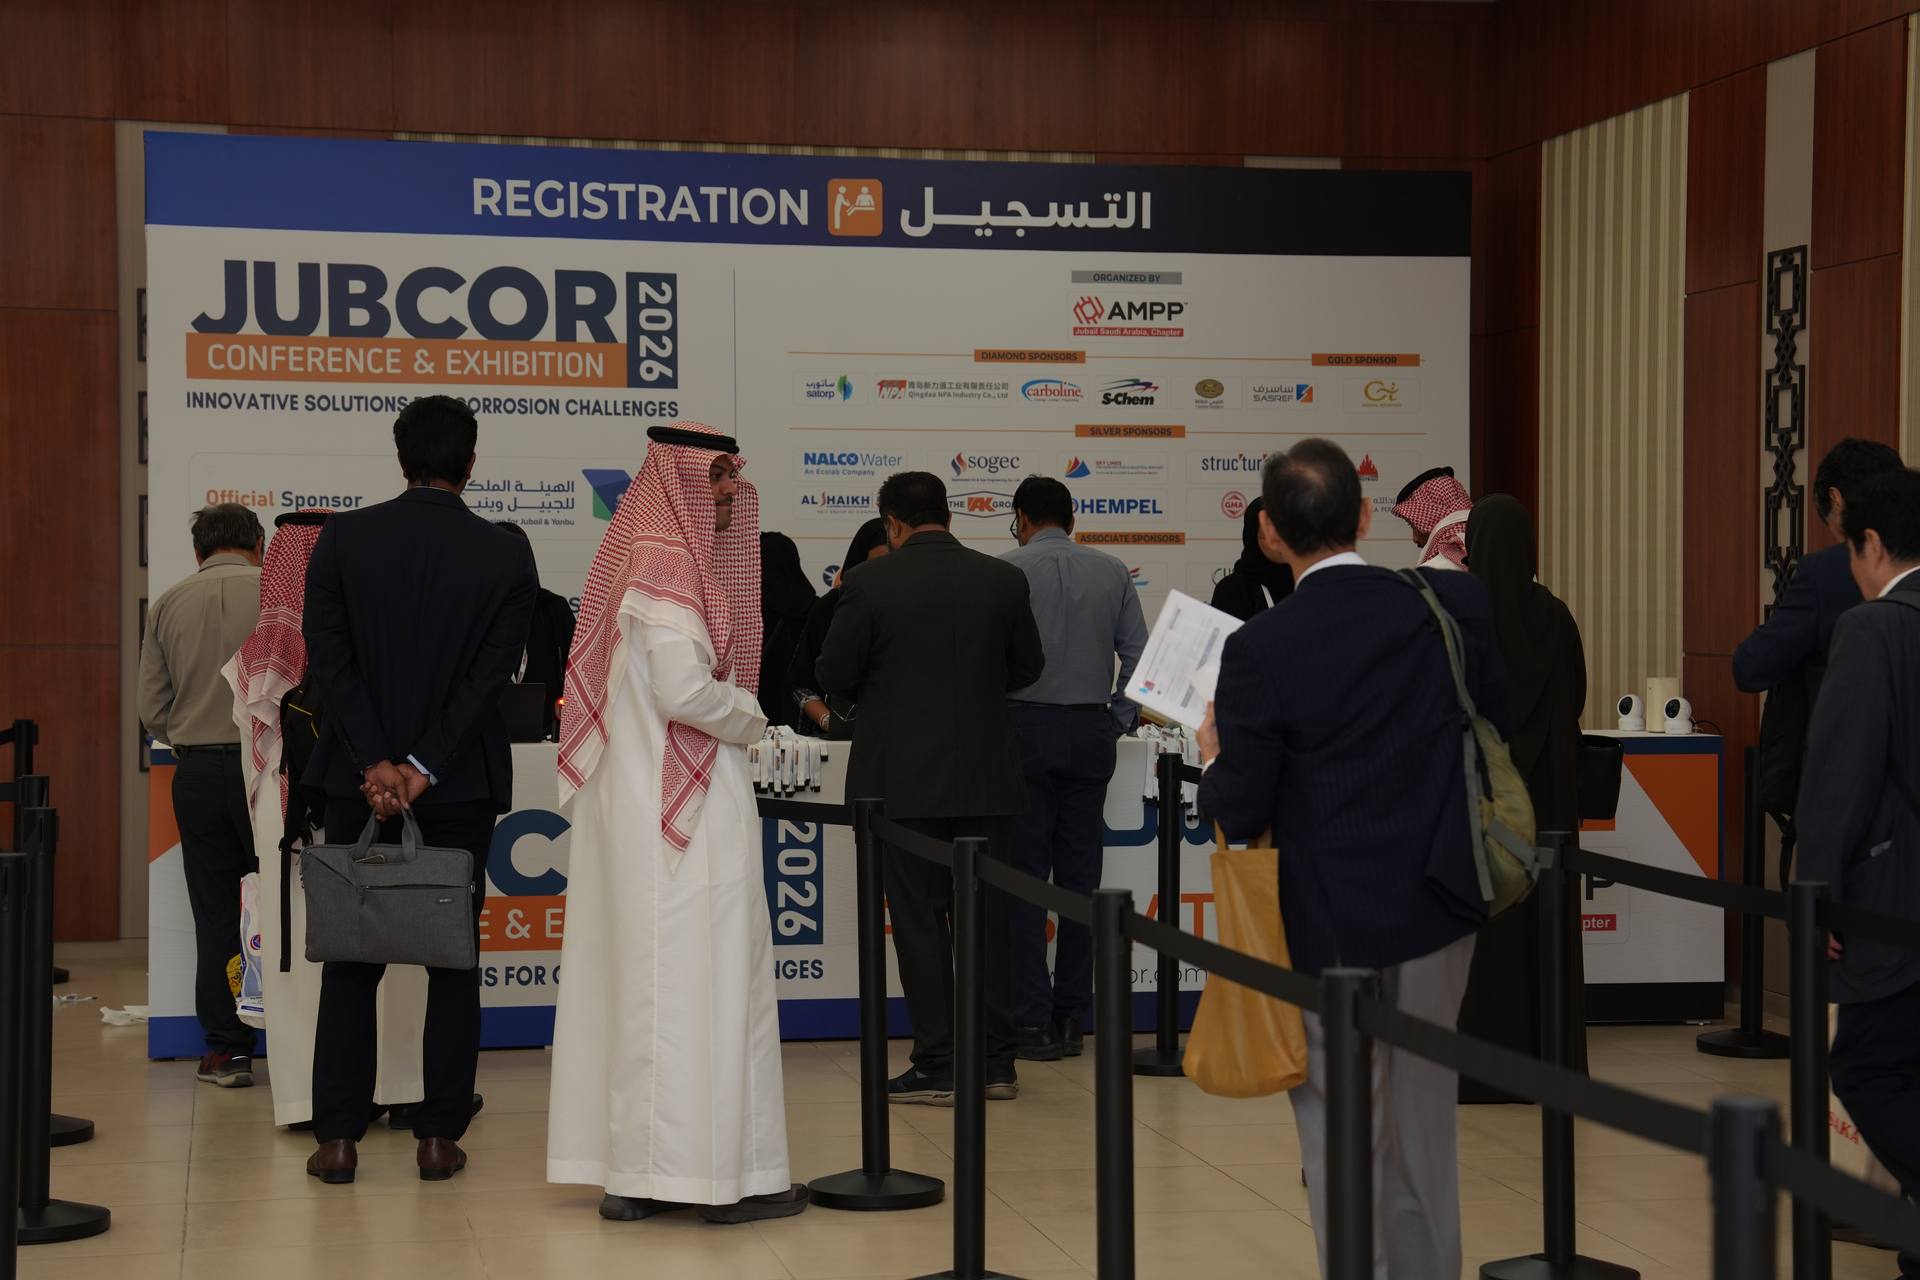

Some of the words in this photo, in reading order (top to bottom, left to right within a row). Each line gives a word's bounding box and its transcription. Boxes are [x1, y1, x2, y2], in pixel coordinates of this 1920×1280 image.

[472, 177, 809, 226] REGISTRATION
[900, 186, 1152, 238] التسجيل
[1093, 273, 1146, 282] ORGANIZED
[1149, 274, 1161, 283] BY
[190, 259, 619, 344] JUBCOR
[1107, 301, 1184, 321] AMPP
[638, 281, 673, 382] 2026
[1075, 327, 1098, 336] Jubail
[1100, 328, 1120, 336] Saudi
[1150, 328, 1181, 338] Chapter
[206, 343, 402, 375] CONFERENCE
[413, 346, 436, 375] &
[445, 348, 605, 379] EXHIBITION
[981, 351, 1026, 360] DIAMOND
[1028, 352, 1078, 361] SPONSORS
[1327, 356, 1353, 364] GOLD
[1354, 356, 1398, 364] SPONSOR
[806, 389, 835, 399] satorp
[908, 391, 936, 399] Qingdao
[953, 391, 981, 399] Industry
[1026, 384, 1081, 397] carboline
[186, 391, 299, 411] INNOVATIVE
[304, 394, 408, 412] SOLUTIONS
[565, 399, 679, 418] CHALLENGES
[1101, 392, 1154, 405] S-Chem
[1252, 394, 1293, 402] SASREF
[1089, 426, 1121, 436] SILVER
[1123, 427, 1172, 436] SPONSORS
[804, 452, 859, 466] NALCO
[859, 453, 902, 466] Water
[967, 455, 1020, 474] sogec
[842, 469, 875, 477] Company
[462, 479, 511, 495] الملك
[206, 489, 275, 507] Official
[281, 490, 363, 511] Sponsor
[467, 497, 504, 512] وينب
[507, 497, 575, 513] للجبيل
[801, 495, 818, 505] AL
[992, 501, 1014, 509] GRO
[1080, 498, 1163, 514] HEMPEL
[520, 518, 543, 526] Jubail
[552, 518, 575, 526] Yanbu
[1080, 534, 1131, 543] ASSOCIATE
[1132, 534, 1180, 543] SPONSORS
[776, 817, 818, 937] 2026
[504, 908, 531, 940] &
[1582, 916, 1611, 930] pter
[504, 965, 546, 986] FOR
